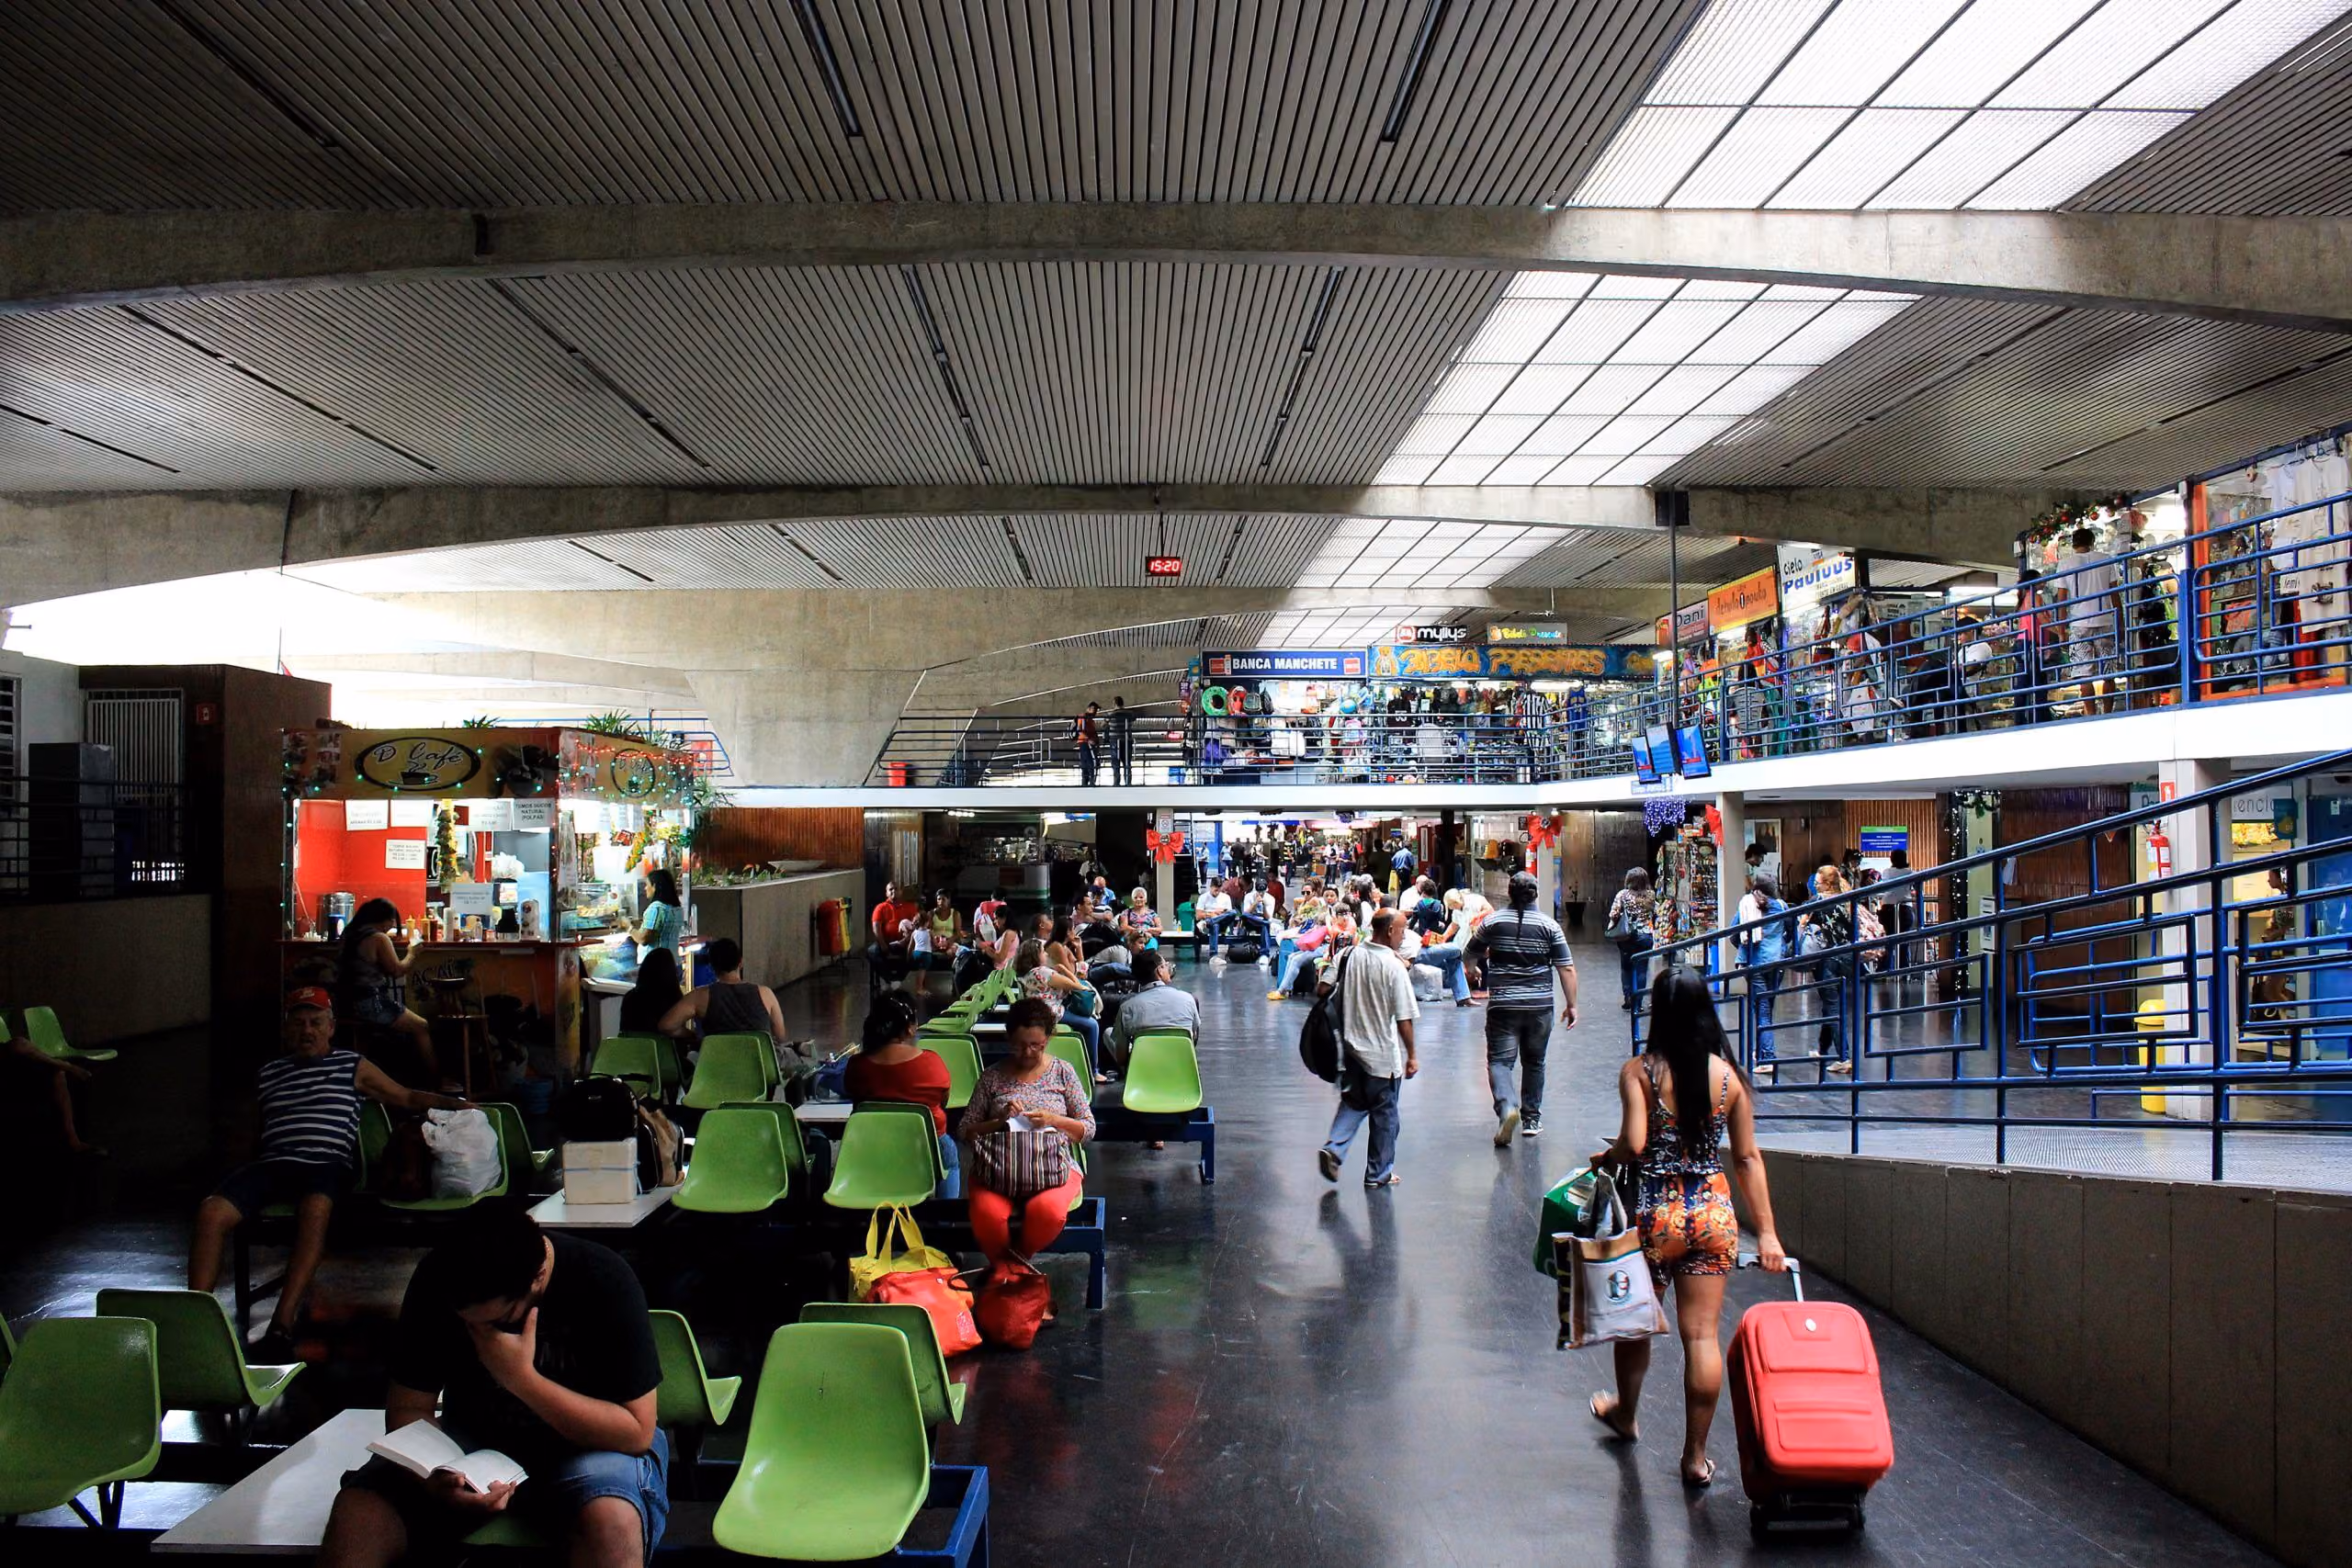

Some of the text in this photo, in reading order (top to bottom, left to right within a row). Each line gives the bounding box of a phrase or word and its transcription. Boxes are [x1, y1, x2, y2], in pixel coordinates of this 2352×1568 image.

[1150, 559, 1180, 571] 15:20
[1783, 557, 1803, 576] cielo
[1676, 606, 1706, 627] Dani
[1417, 626, 1467, 641] myllys
[1233, 658, 1272, 670] BANCA
[1274, 658, 1338, 670] MANCHETE
[374, 742, 463, 771] D Café
